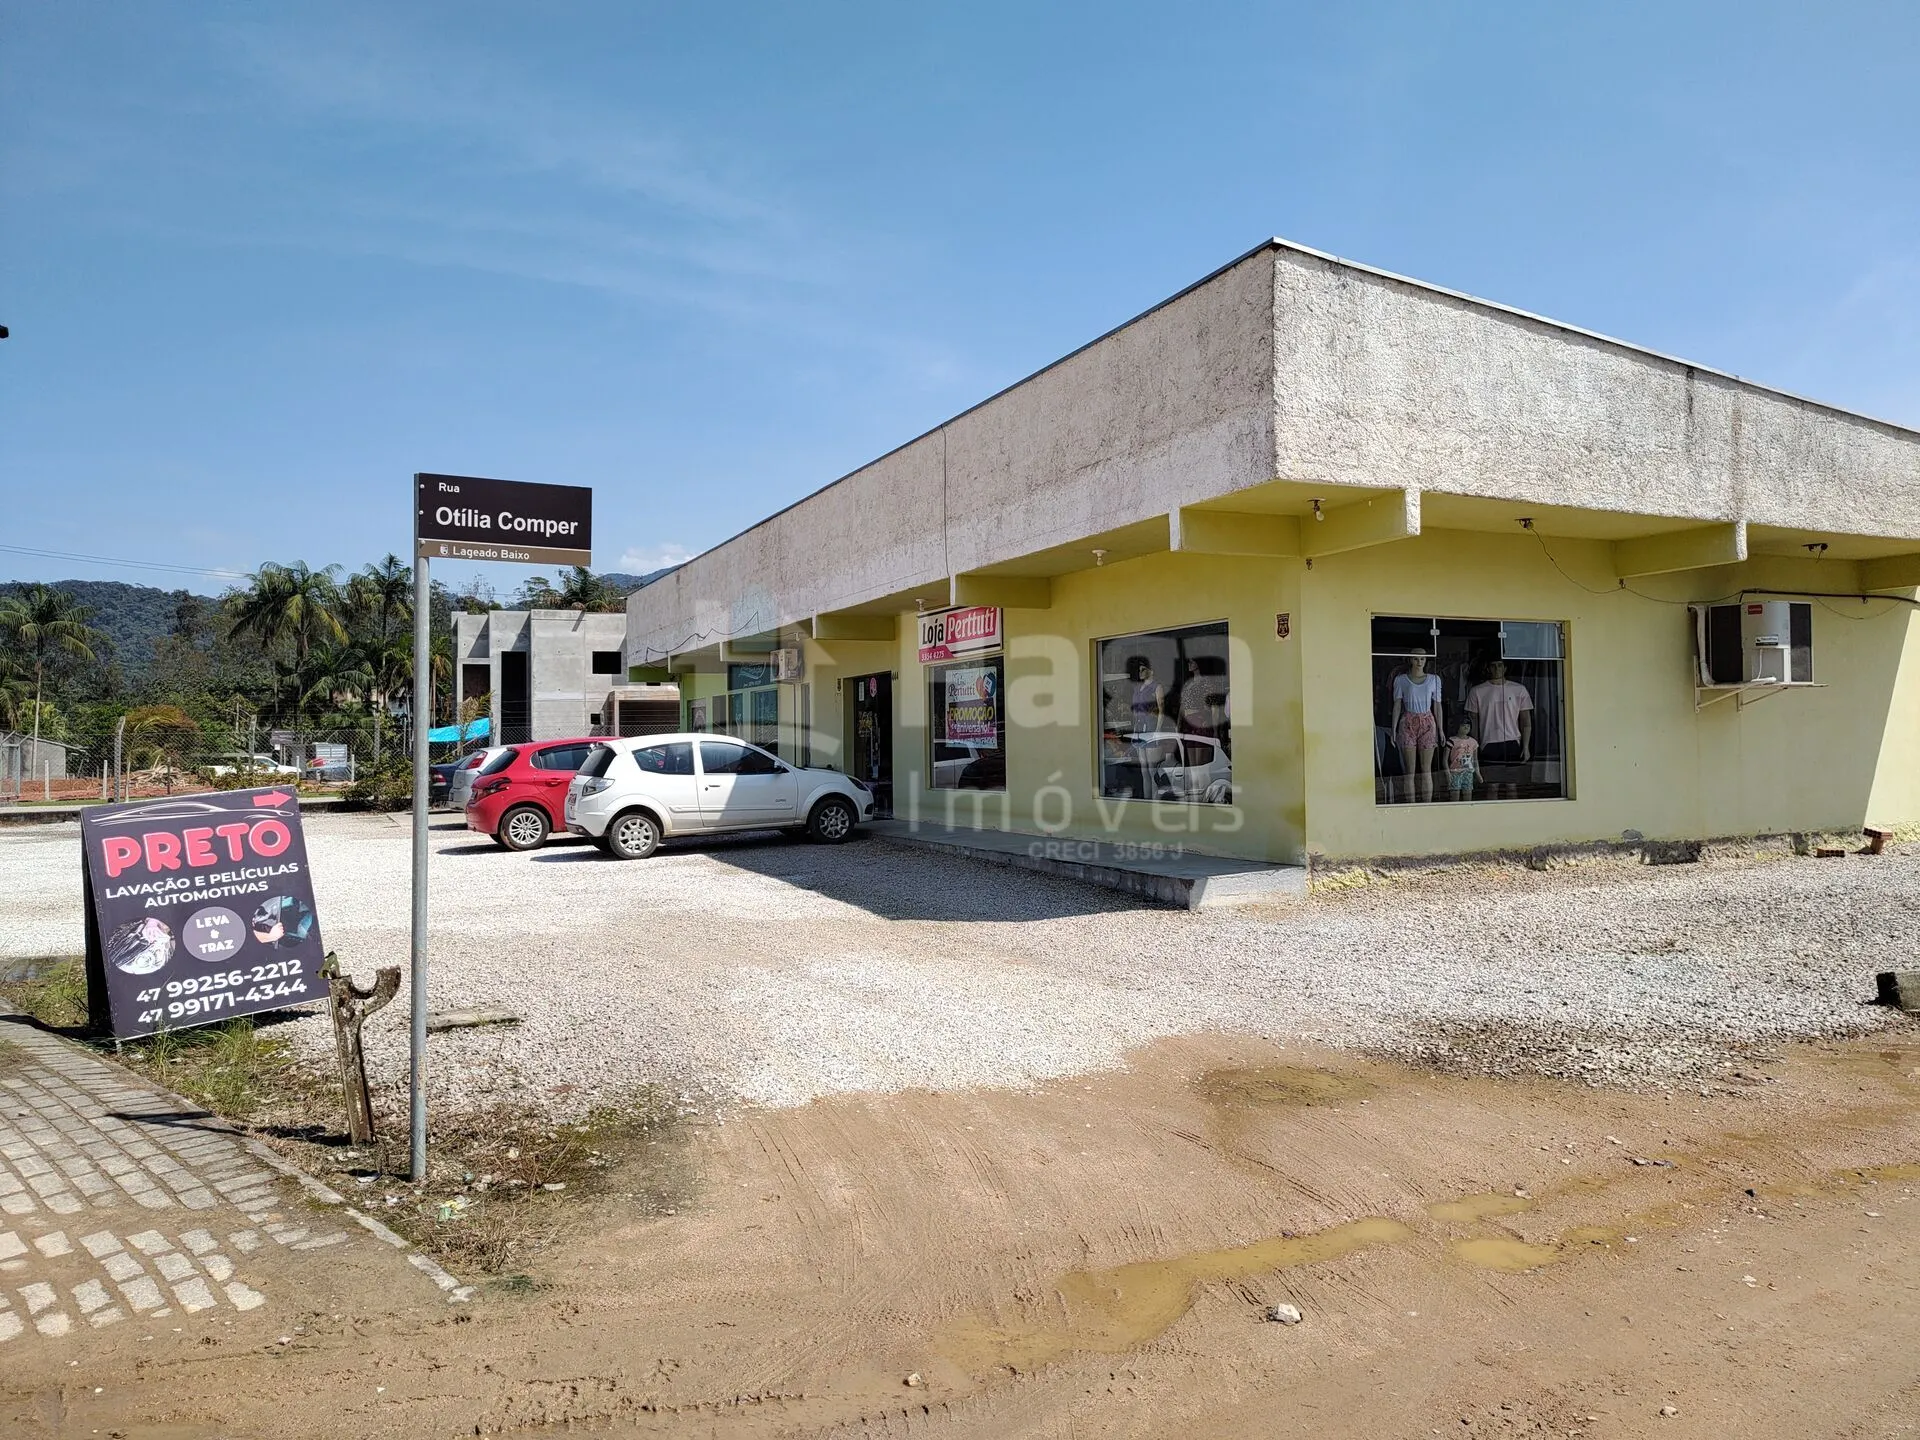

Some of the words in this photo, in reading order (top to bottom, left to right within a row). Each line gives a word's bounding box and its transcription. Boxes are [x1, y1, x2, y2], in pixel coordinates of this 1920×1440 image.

[438, 482, 460, 493] Rua
[435, 506, 491, 529] Otília
[497, 511, 579, 538] Comper
[453, 546, 498, 559] Lageado
[501, 549, 530, 560] Baixo
[922, 618, 944, 649] Loja
[947, 606, 995, 641] Perttuti
[102, 819, 291, 878] PRETO
[105, 877, 190, 899] LAVAÇÃO
[195, 875, 205, 887] E
[210, 862, 299, 885] PELÍCULAS
[144, 880, 269, 909] AUTOMOTIVAS
[195, 914, 230, 929] LEVA
[198, 939, 235, 954] TRAZ
[136, 987, 161, 1003] 47
[166, 959, 303, 998] 99256-2212
[137, 1008, 163, 1024] 47
[168, 978, 307, 1019] 99171-4344
